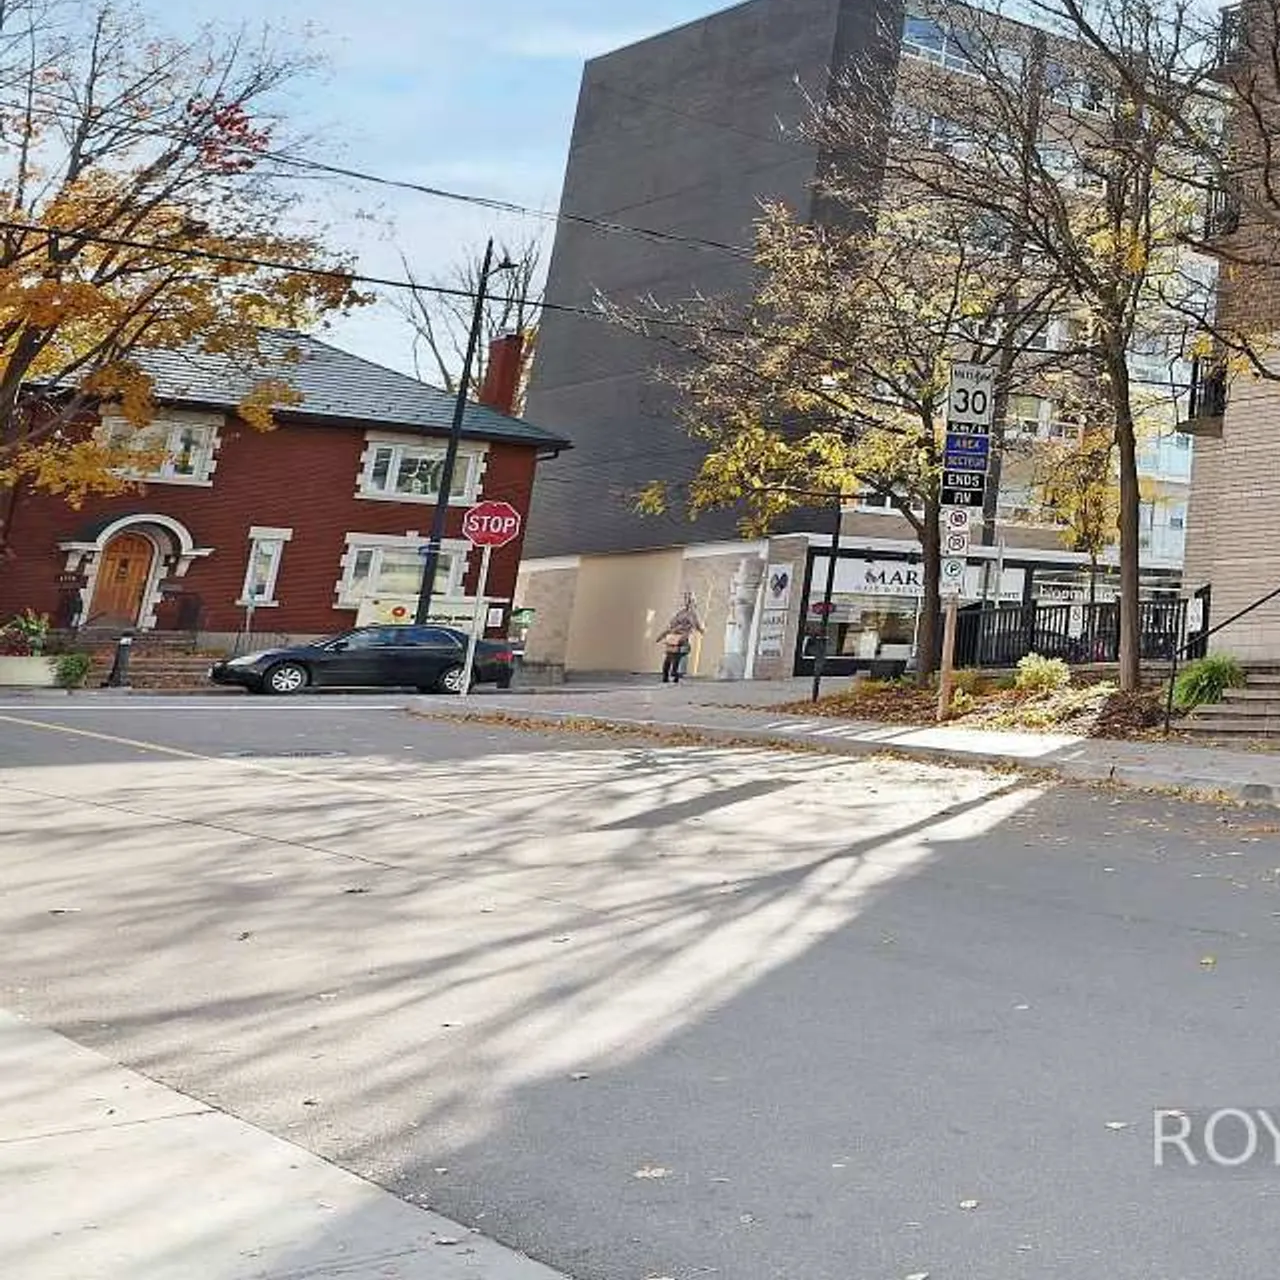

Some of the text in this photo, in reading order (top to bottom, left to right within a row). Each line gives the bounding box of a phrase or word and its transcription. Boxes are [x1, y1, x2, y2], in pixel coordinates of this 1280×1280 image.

[954, 388, 987, 415] 30
[947, 474, 980, 487] ENDS
[467, 515, 516, 534] STOP
[864, 569, 922, 586] MAR
